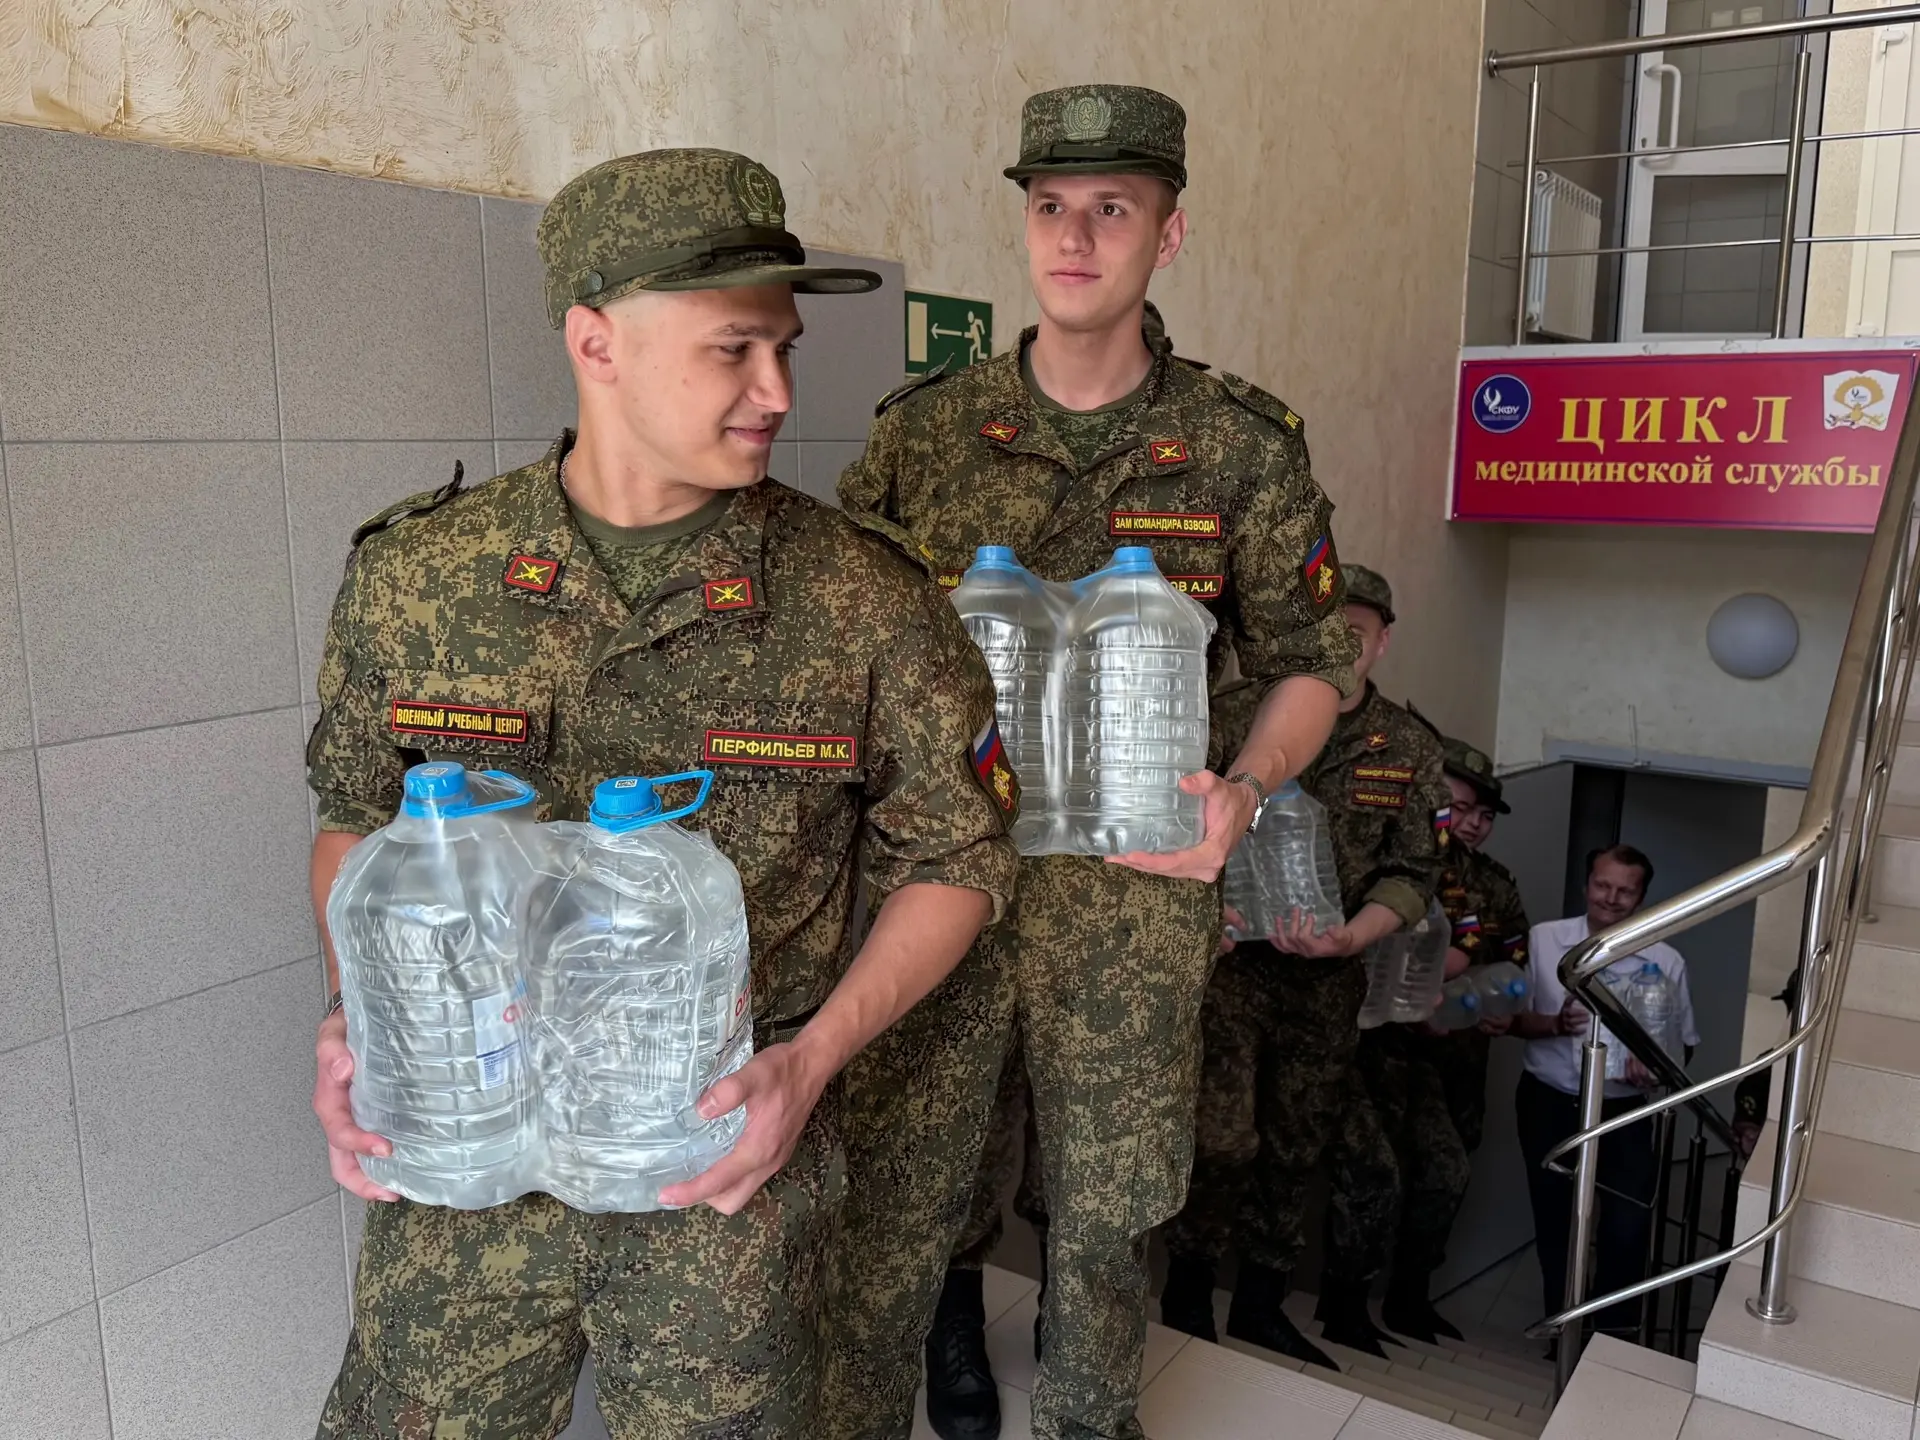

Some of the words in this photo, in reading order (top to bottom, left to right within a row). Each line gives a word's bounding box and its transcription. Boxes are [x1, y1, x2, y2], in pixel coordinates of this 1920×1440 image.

[1491, 405, 1520, 415] СКФУ
[1556, 396, 1791, 453] ЦИКЛ
[1475, 456, 1713, 485] медицинской
[1725, 456, 1881, 493] службы
[1115, 517, 1132, 529] ЗАМ
[1133, 518, 1182, 531] КОМАНДИРА
[1183, 520, 1216, 533] ВЗВОДА
[1190, 581, 1217, 592] А.И.
[396, 708, 444, 728] ВОЕННЫЙ
[447, 712, 492, 732] УЧЕБНЫЙ
[495, 717, 523, 735] ЦЕНТР
[711, 738, 816, 758] ПЕРФИЛЬЕВ
[820, 744, 850, 759] М.К.
